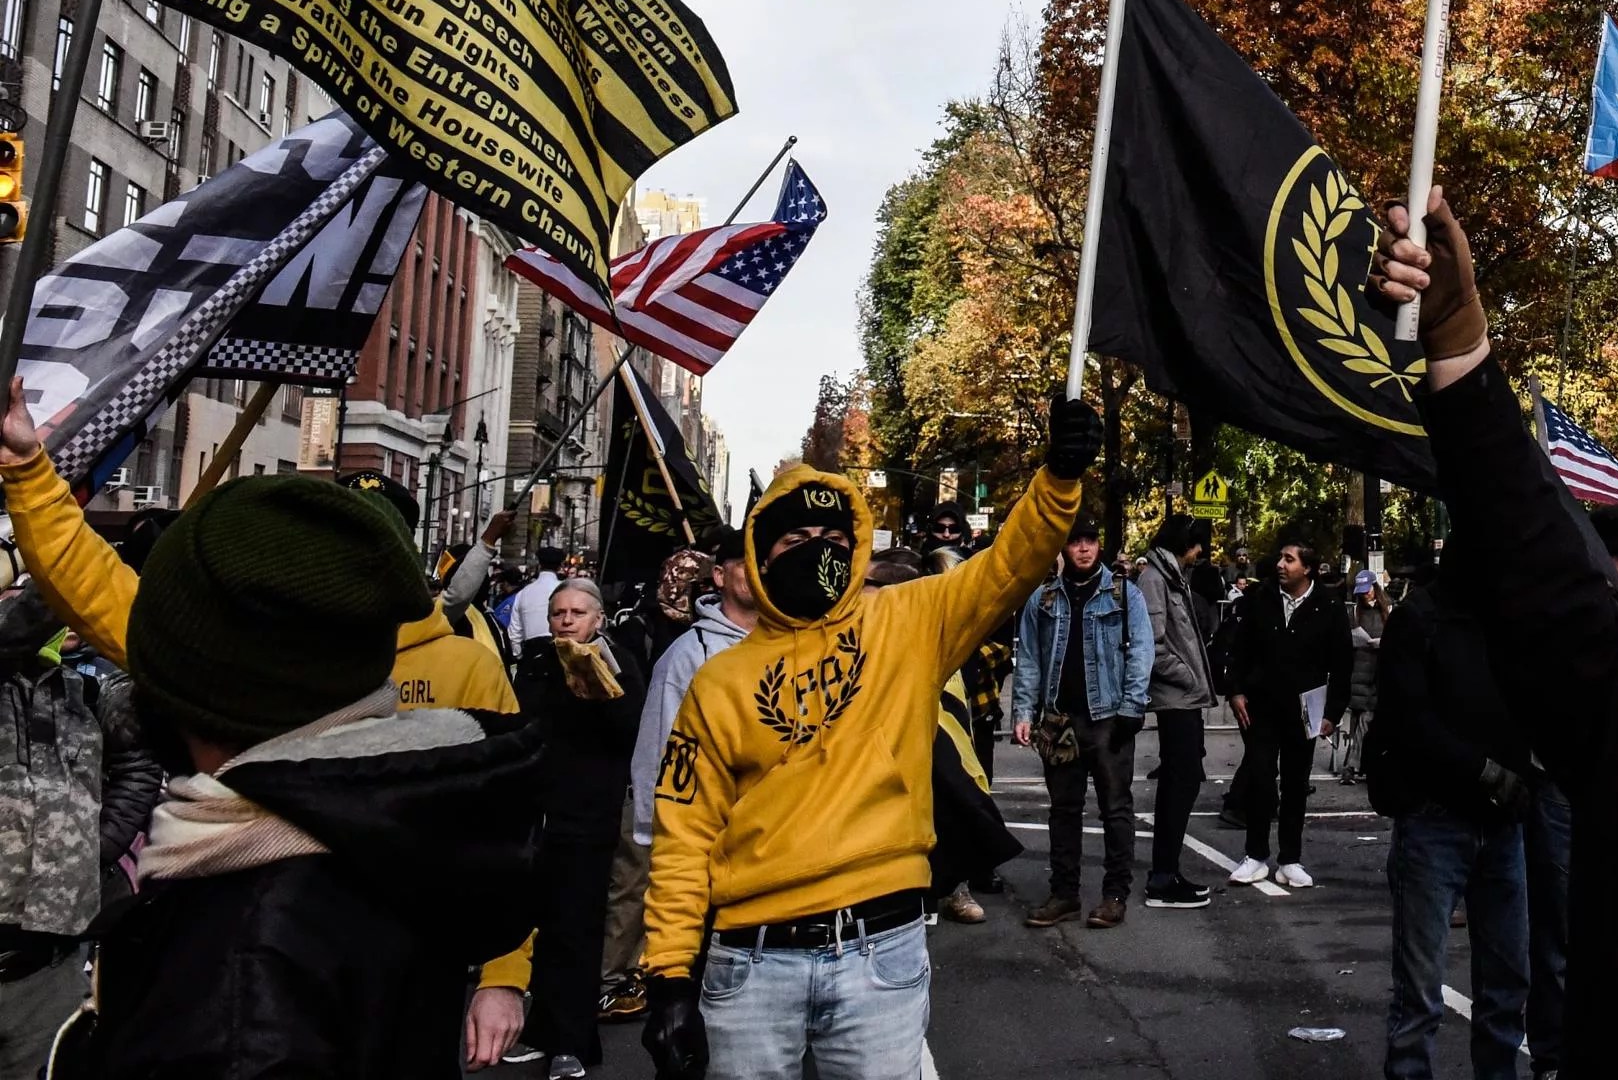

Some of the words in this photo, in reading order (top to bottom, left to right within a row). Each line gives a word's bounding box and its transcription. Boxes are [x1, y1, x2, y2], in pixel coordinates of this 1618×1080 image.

[434, 17, 521, 92] Rights
[575, 3, 620, 57] War
[359, 9, 398, 54] the
[405, 46, 574, 178] Entrepreneur
[370, 54, 409, 105] the
[417, 97, 565, 203] Housewife
[260, 14, 281, 34] a
[292, 26, 356, 96] Spirit
[357, 97, 383, 121] of
[388, 116, 512, 209] Western
[521, 199, 595, 270] Chauvi
[1194, 507, 1225, 516] SCHOOL
[400, 679, 436, 704] GIRL
